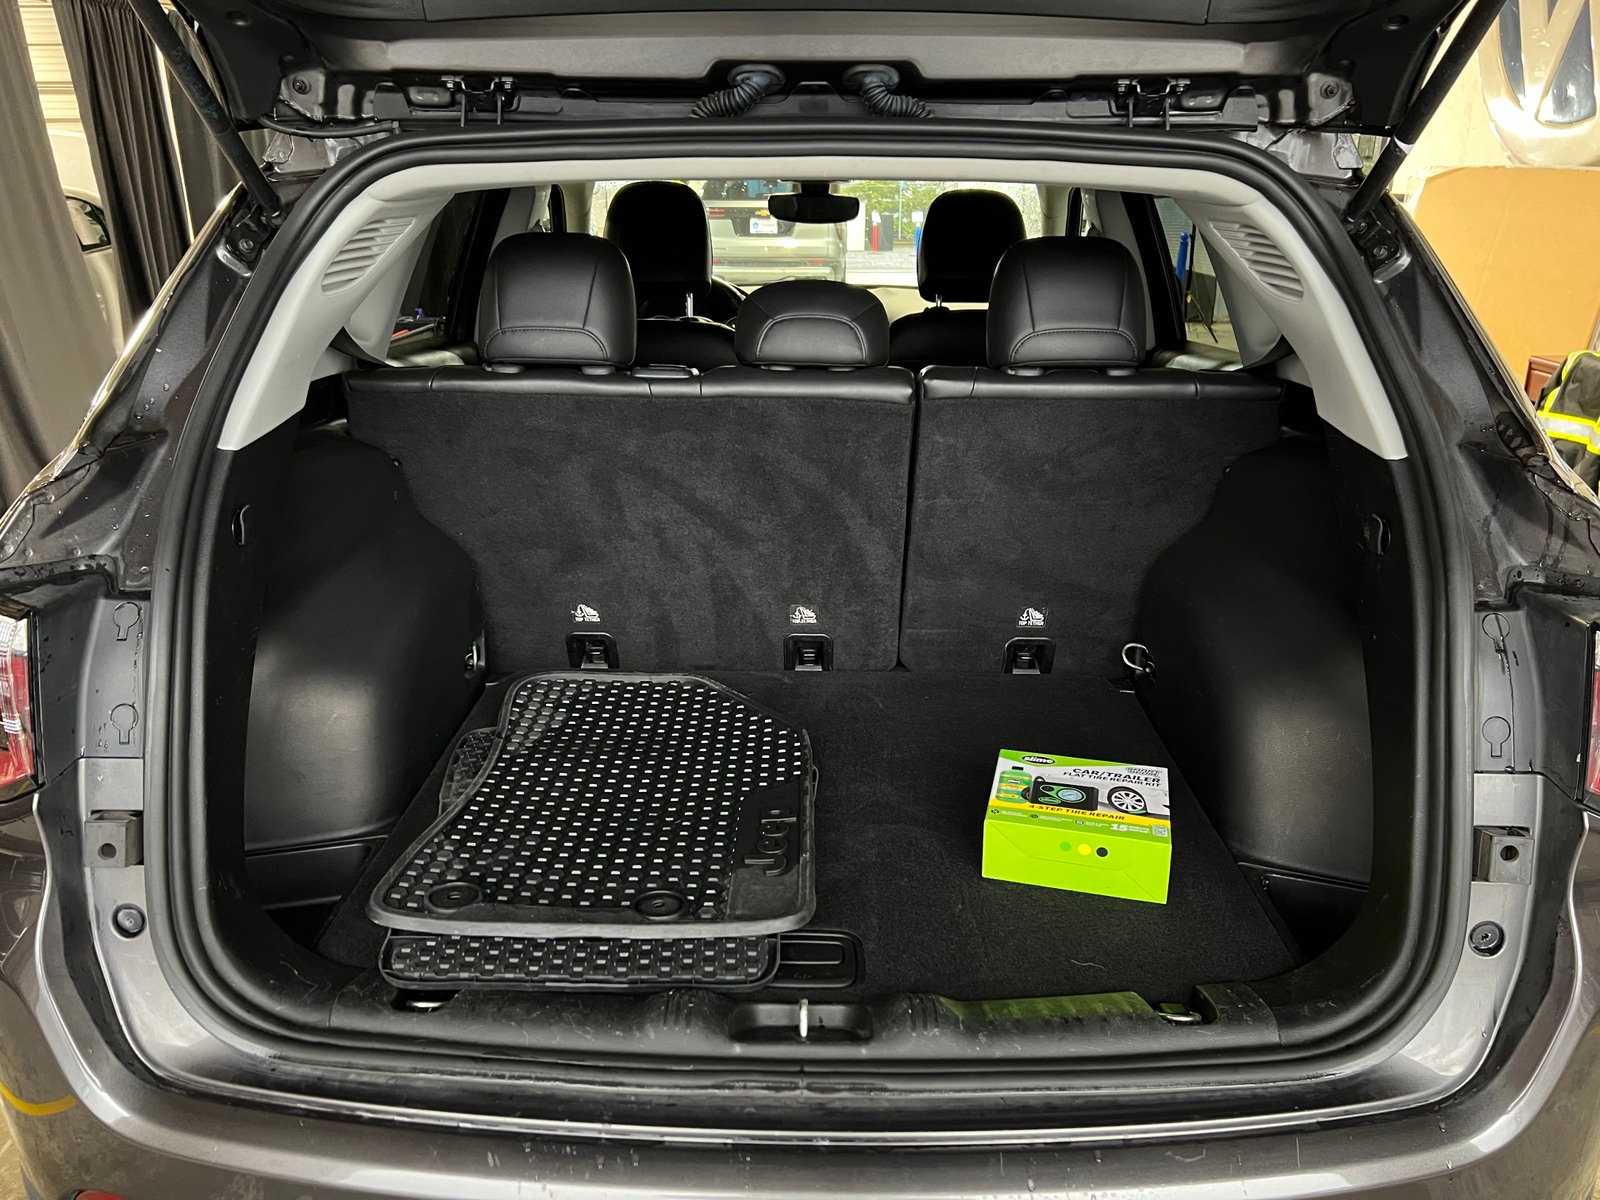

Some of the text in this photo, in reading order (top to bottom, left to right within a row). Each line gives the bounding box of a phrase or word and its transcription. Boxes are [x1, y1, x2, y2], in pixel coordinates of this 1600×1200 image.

[1023, 756, 1054, 764] slime
[1073, 768, 1161, 783] CAR/TRAILER
[1109, 777, 1143, 785] REPAIR
[1089, 812, 1125, 820] REPAIR
[1110, 823, 1128, 831] 15
[744, 808, 797, 877] Jeep
